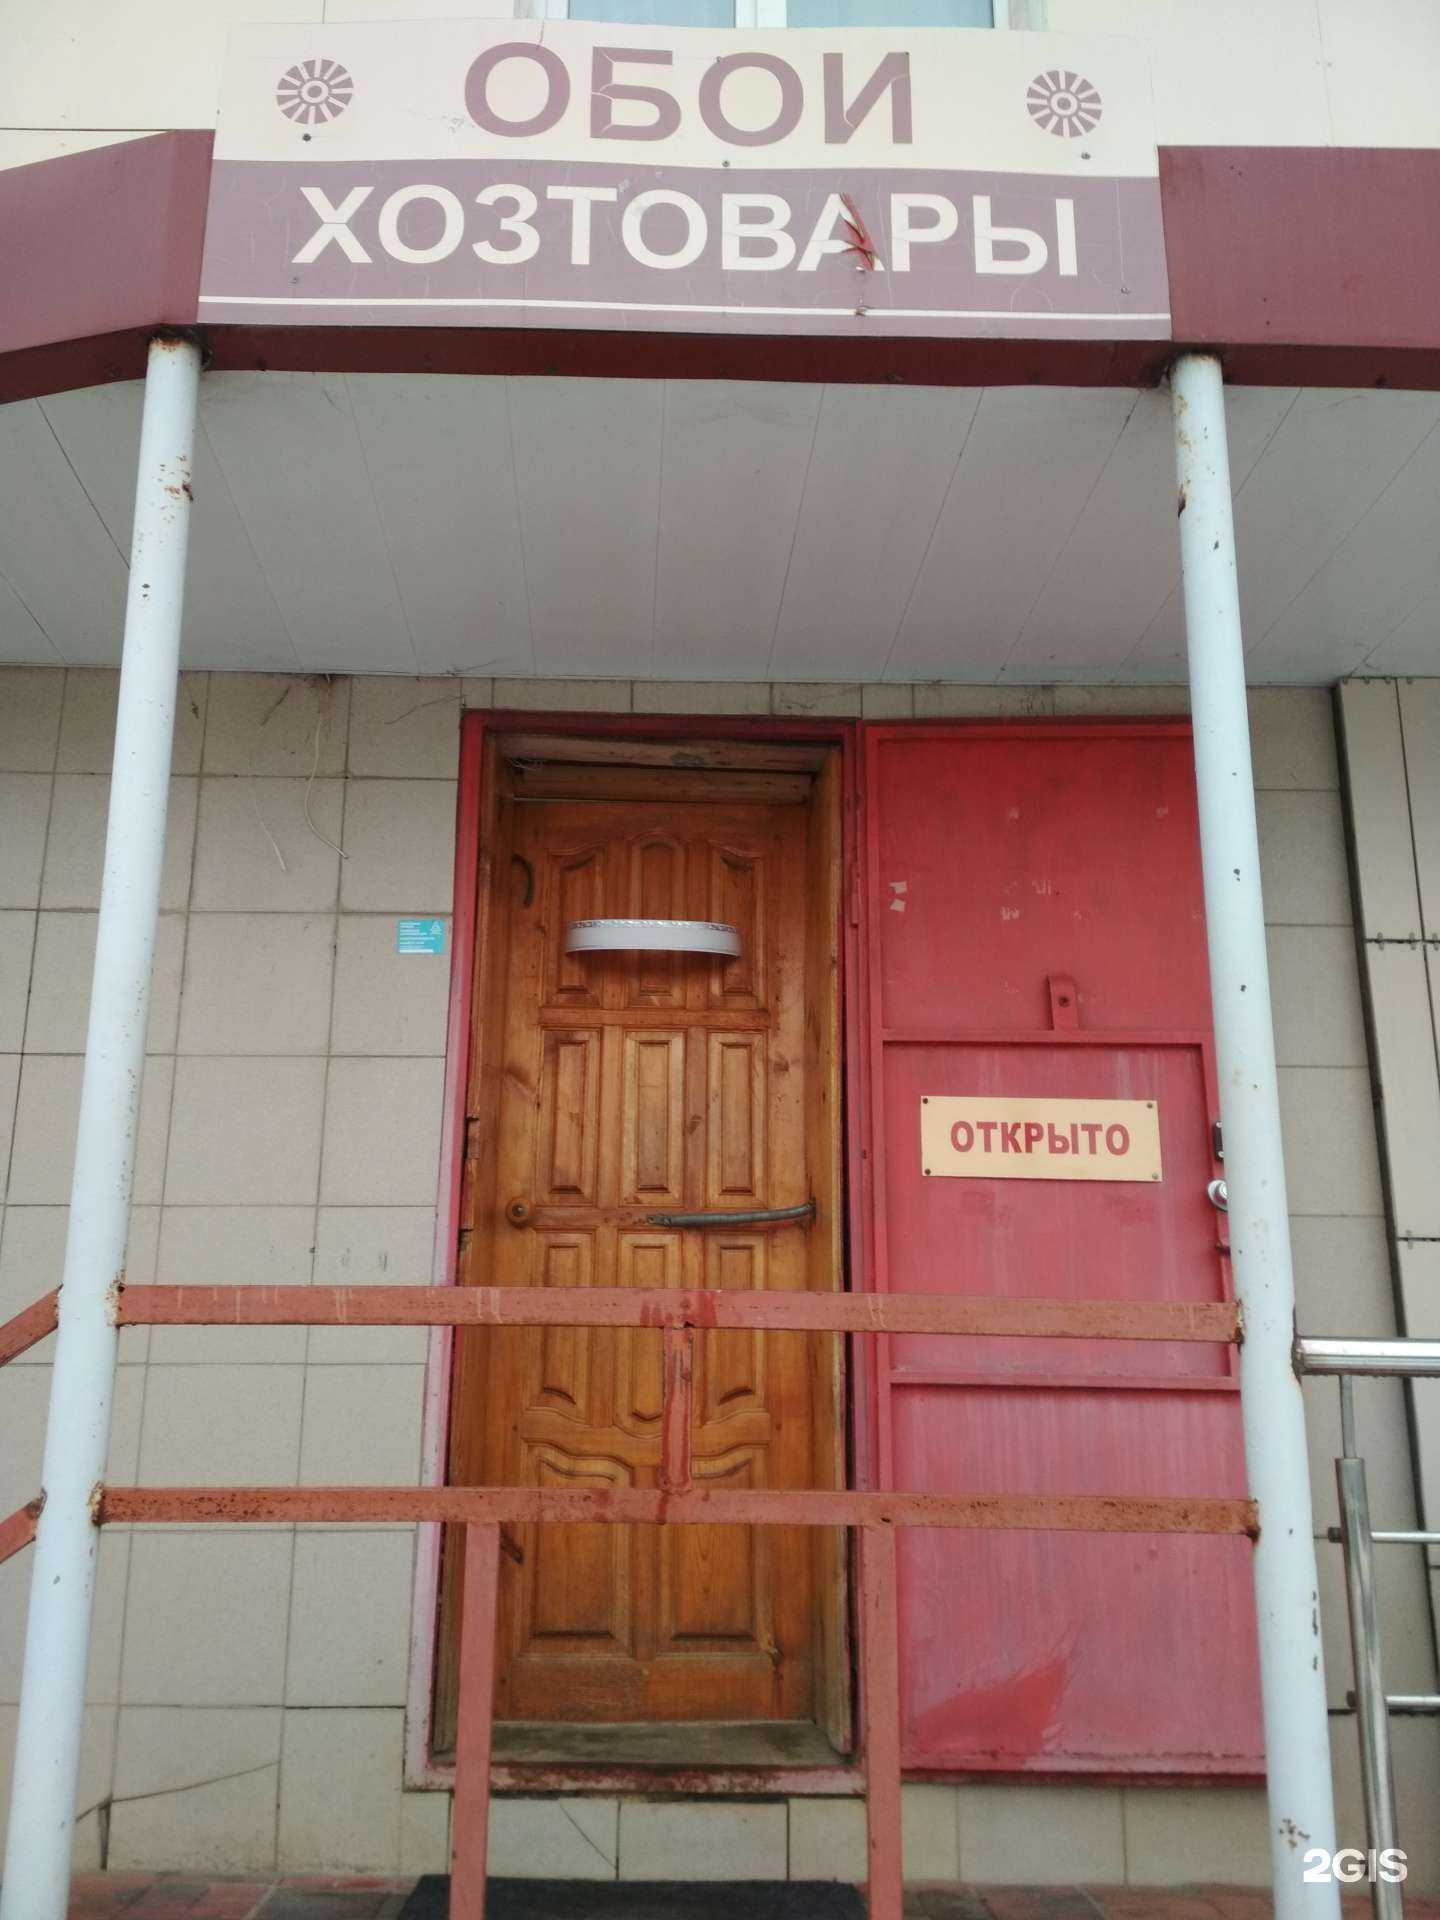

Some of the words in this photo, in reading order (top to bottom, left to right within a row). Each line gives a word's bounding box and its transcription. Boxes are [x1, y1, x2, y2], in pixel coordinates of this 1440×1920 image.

[464, 42, 912, 147] ОБОИ
[291, 184, 1078, 277] ХОЗТОВАРЫ
[950, 1120, 1130, 1155] ОТКРЫТО
